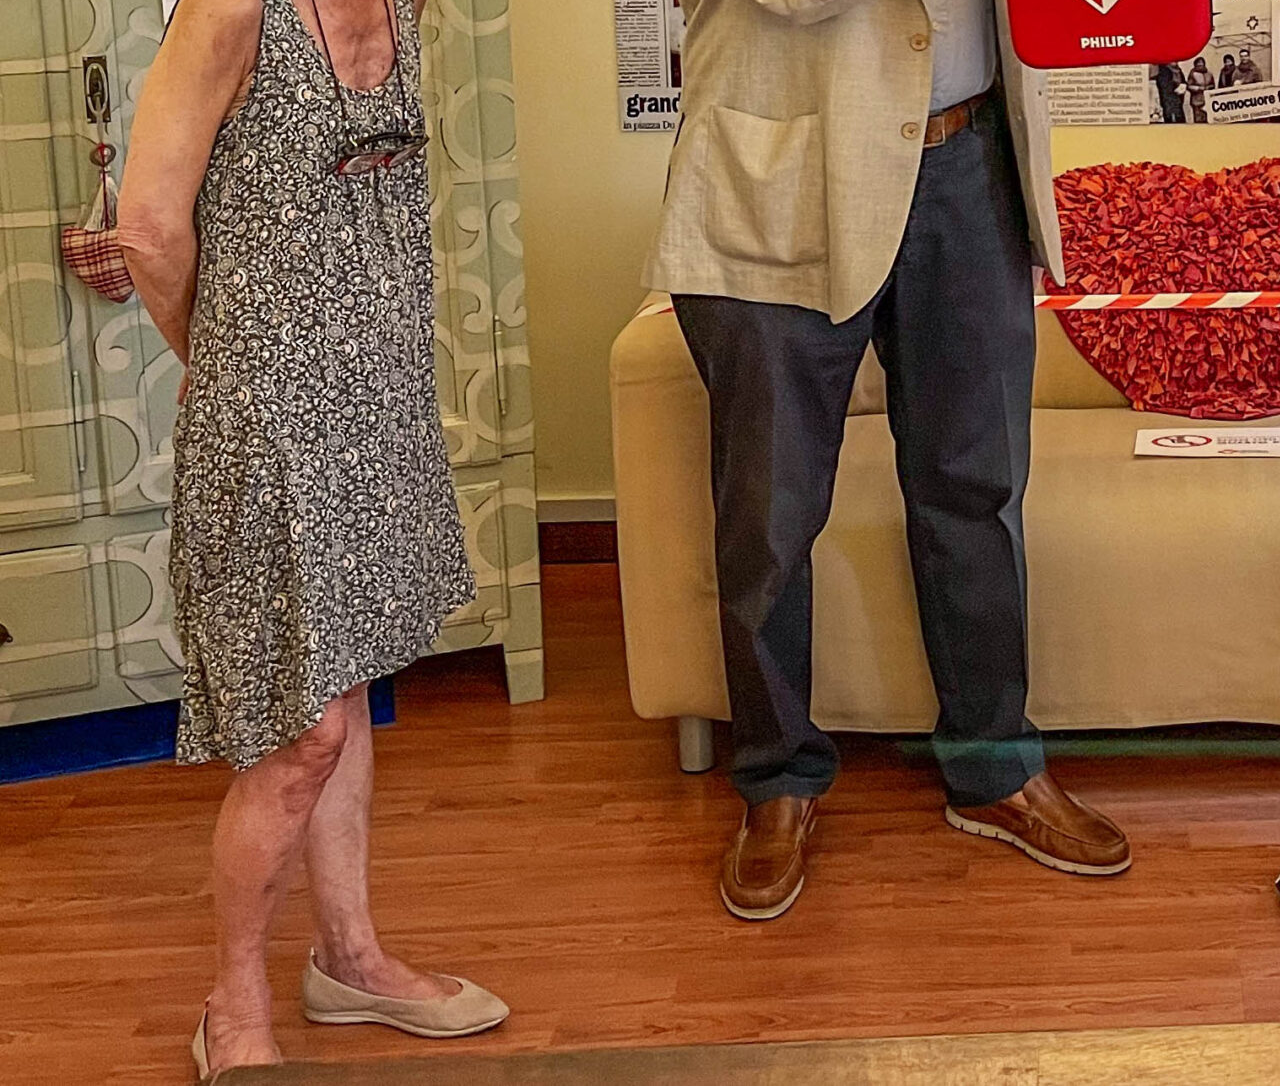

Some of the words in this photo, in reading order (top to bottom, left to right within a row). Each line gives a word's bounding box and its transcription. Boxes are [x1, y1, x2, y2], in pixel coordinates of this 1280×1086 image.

[1080, 34, 1135, 50] PHILIPS
[1211, 91, 1276, 113] Comocuore
[662, 120, 675, 130] Du
